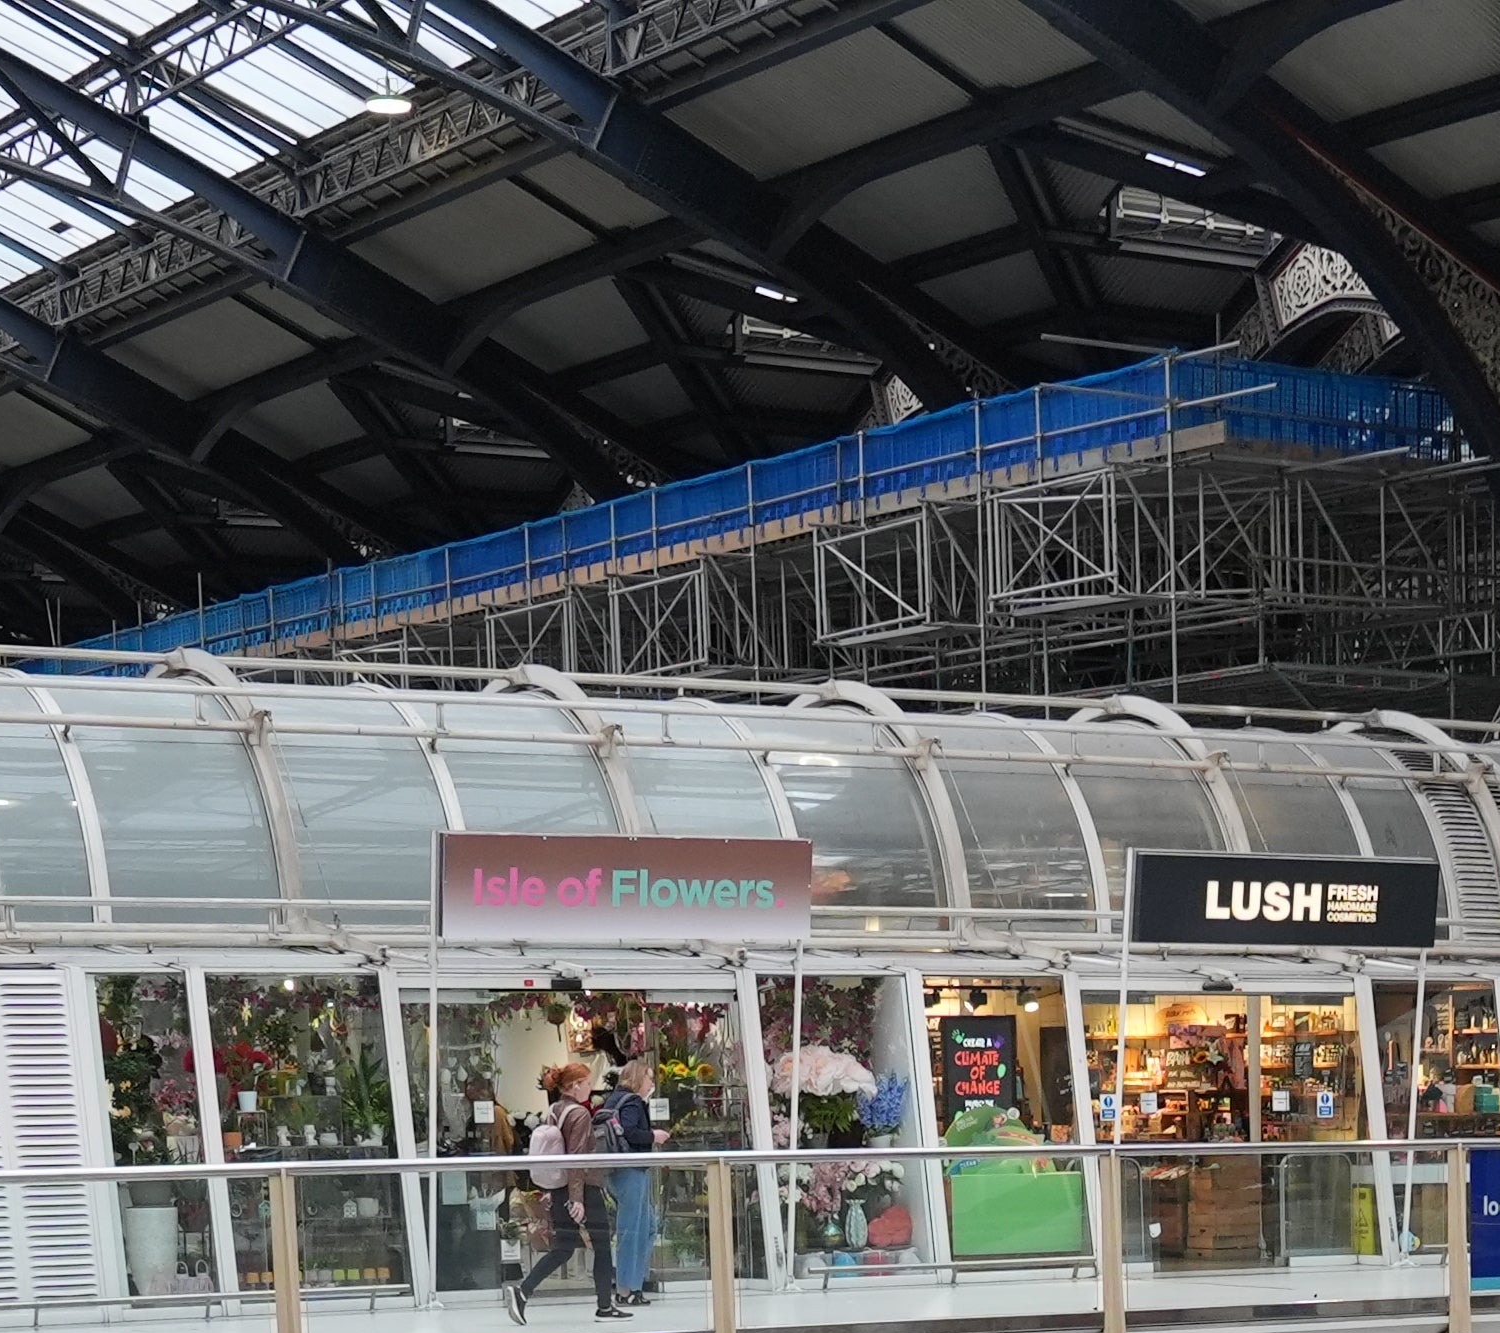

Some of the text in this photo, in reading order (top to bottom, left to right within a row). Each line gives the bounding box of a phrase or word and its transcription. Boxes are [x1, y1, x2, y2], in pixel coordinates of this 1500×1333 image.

[473, 867, 545, 907] Isle
[555, 867, 602, 907] of
[1206, 880, 1379, 922] LUSH FRESH
[1327, 902, 1378, 912] HANDMADE
[1326, 912, 1377, 923] COSMETICS
[955, 1051, 1000, 1066] CLIMATE
[969, 1066, 986, 1080] OF
[955, 1080, 1000, 1096] CHANGE
